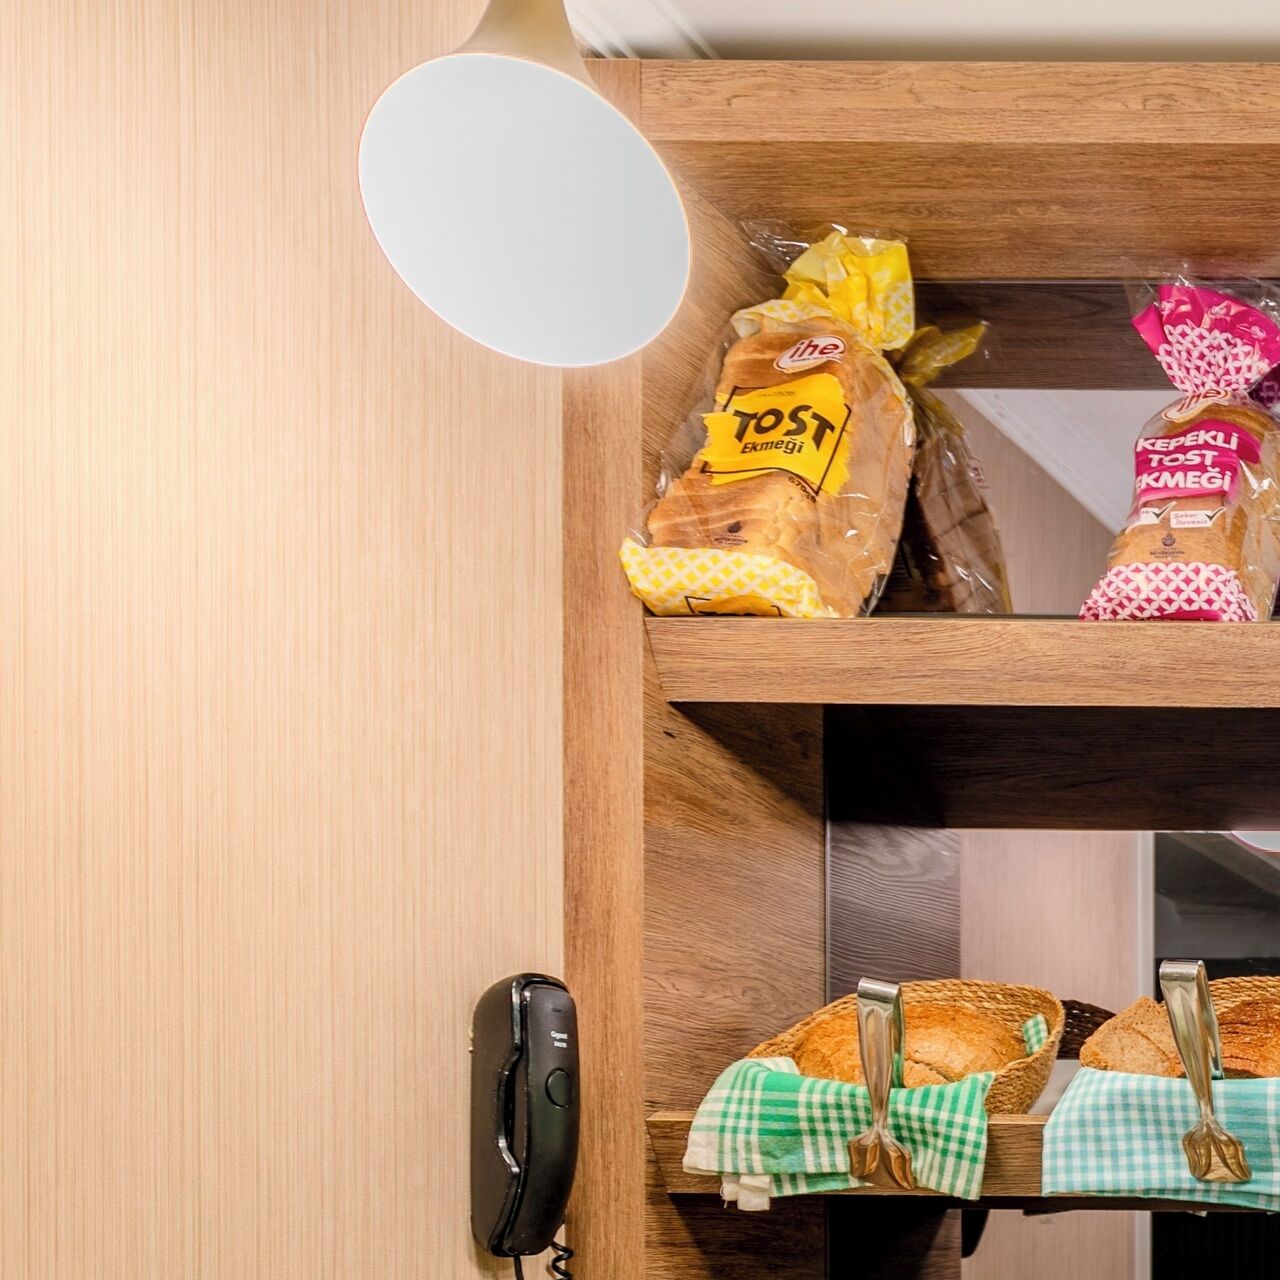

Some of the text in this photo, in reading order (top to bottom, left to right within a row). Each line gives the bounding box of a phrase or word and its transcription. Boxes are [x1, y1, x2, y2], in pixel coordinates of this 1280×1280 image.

[732, 404, 836, 452] TOST
[740, 437, 805, 455] Ekmeği
[1136, 430, 1239, 452] KEPEKLİ
[1147, 450, 1219, 467] TOST
